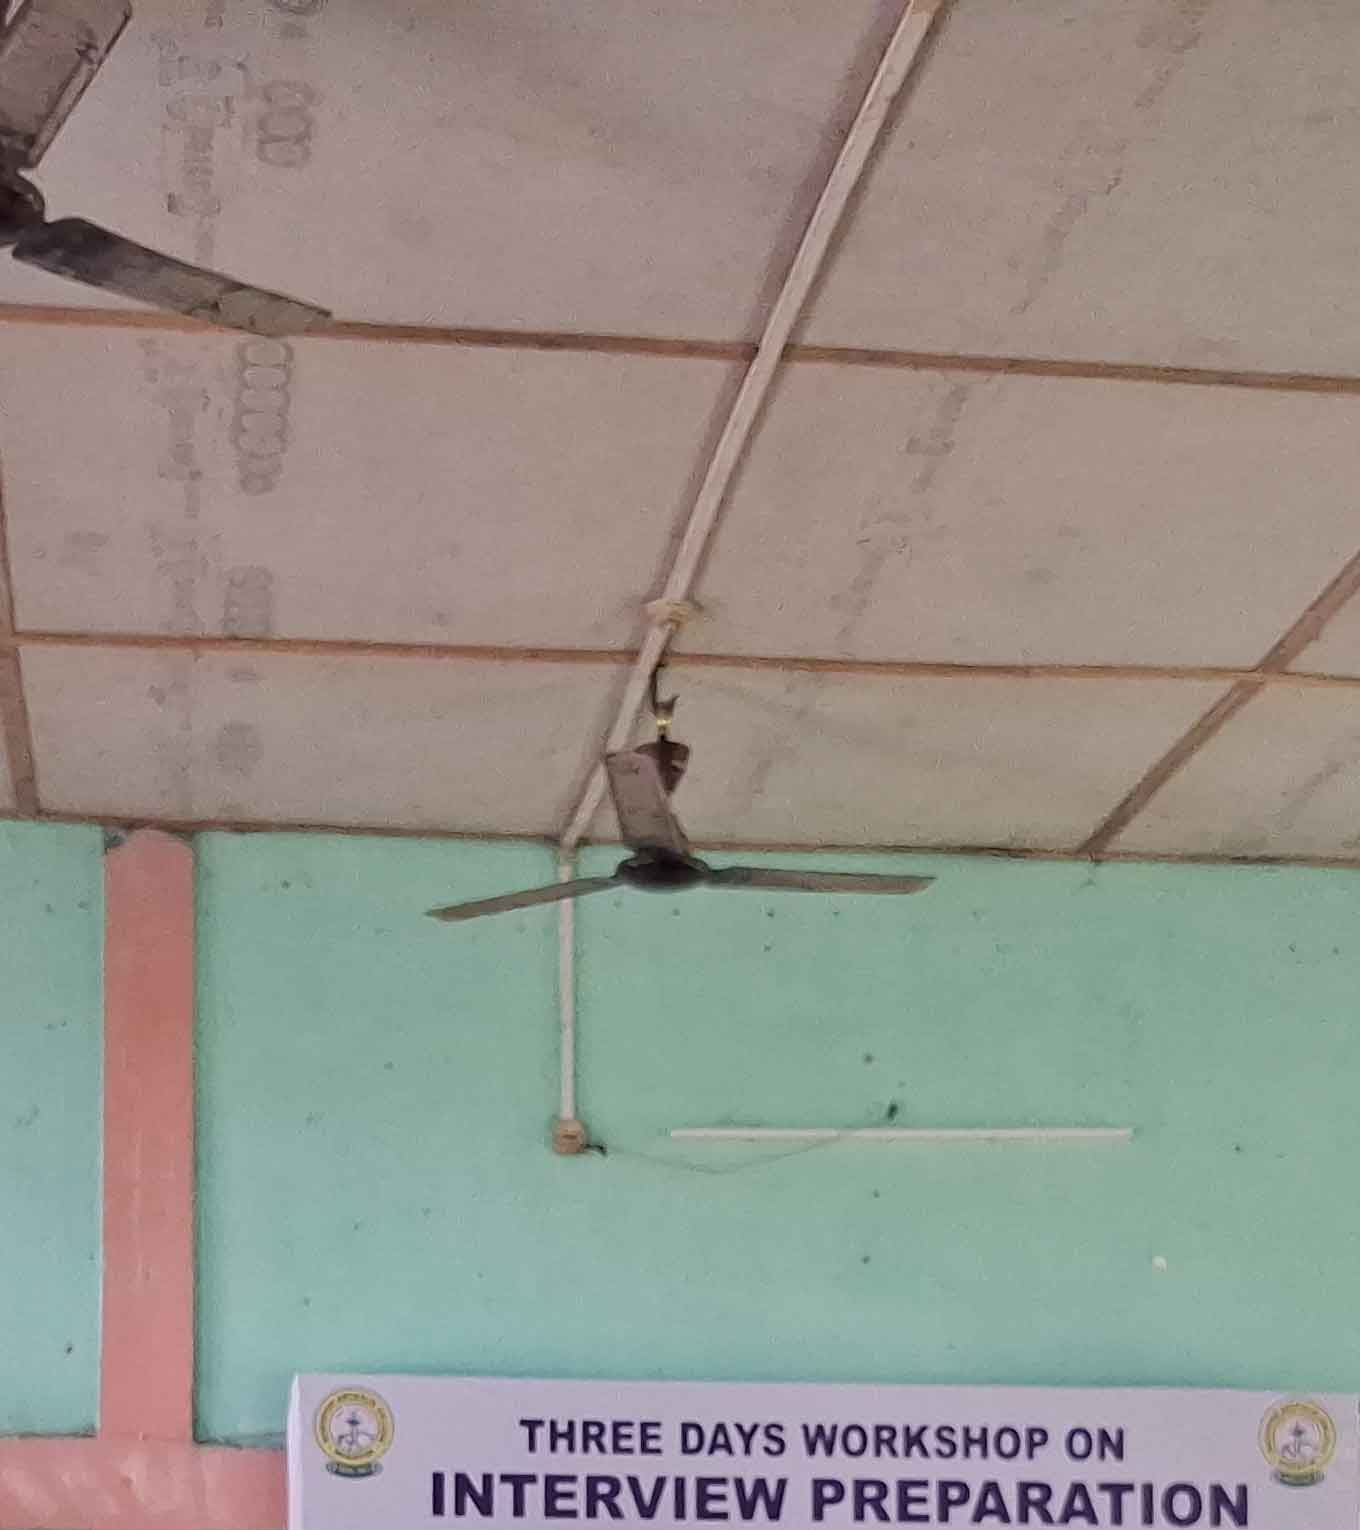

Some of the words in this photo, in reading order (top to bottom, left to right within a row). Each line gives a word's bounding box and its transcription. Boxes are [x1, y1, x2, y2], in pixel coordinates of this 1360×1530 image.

[519, 1419, 663, 1455] THREE
[680, 1421, 787, 1457] DAYS
[802, 1423, 1049, 1460] WORKSHOP
[1065, 1427, 1125, 1462] ON
[431, 1472, 788, 1521] INTERVIEW
[811, 1478, 1249, 1527] PREPARATION
